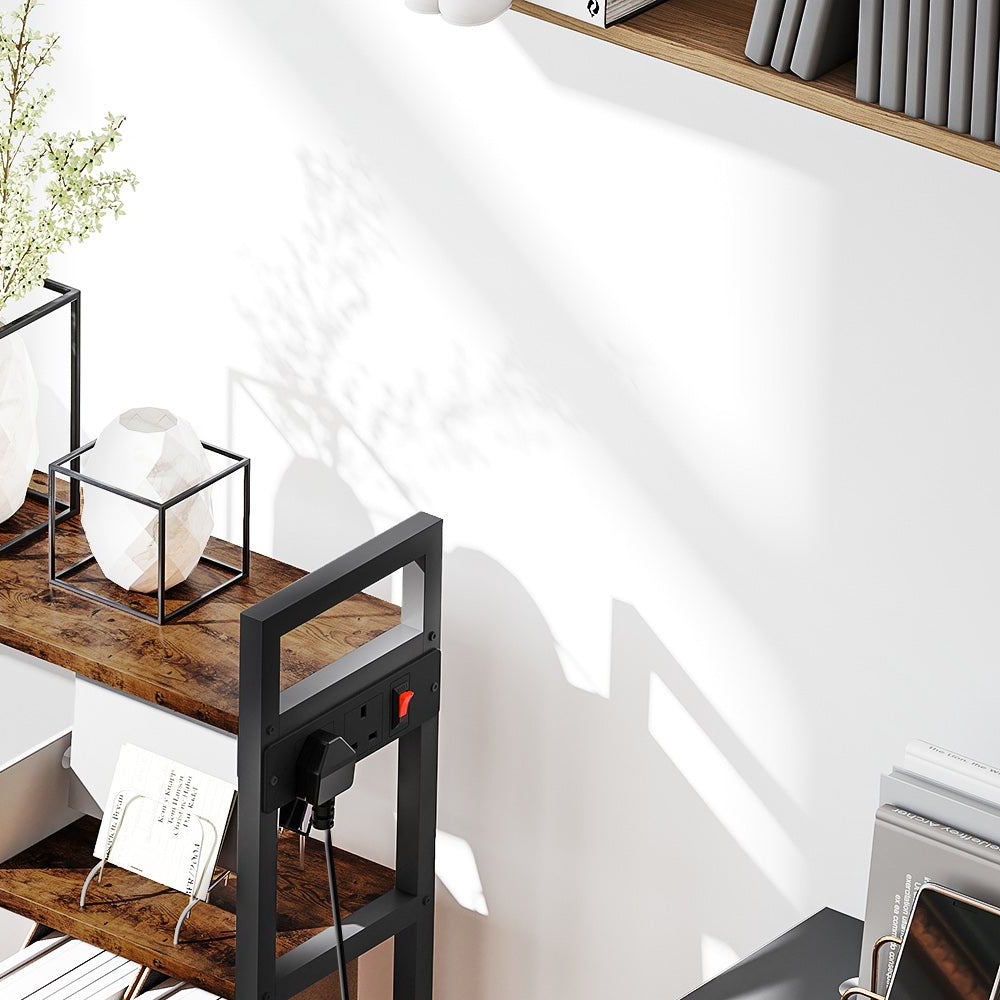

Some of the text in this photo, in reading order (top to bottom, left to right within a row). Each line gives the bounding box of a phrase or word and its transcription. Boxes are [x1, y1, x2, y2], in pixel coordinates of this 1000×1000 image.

[167, 776, 184, 824] Tom Hansen
[173, 798, 187, 836] Christne
[891, 808, 940, 827] Archer
